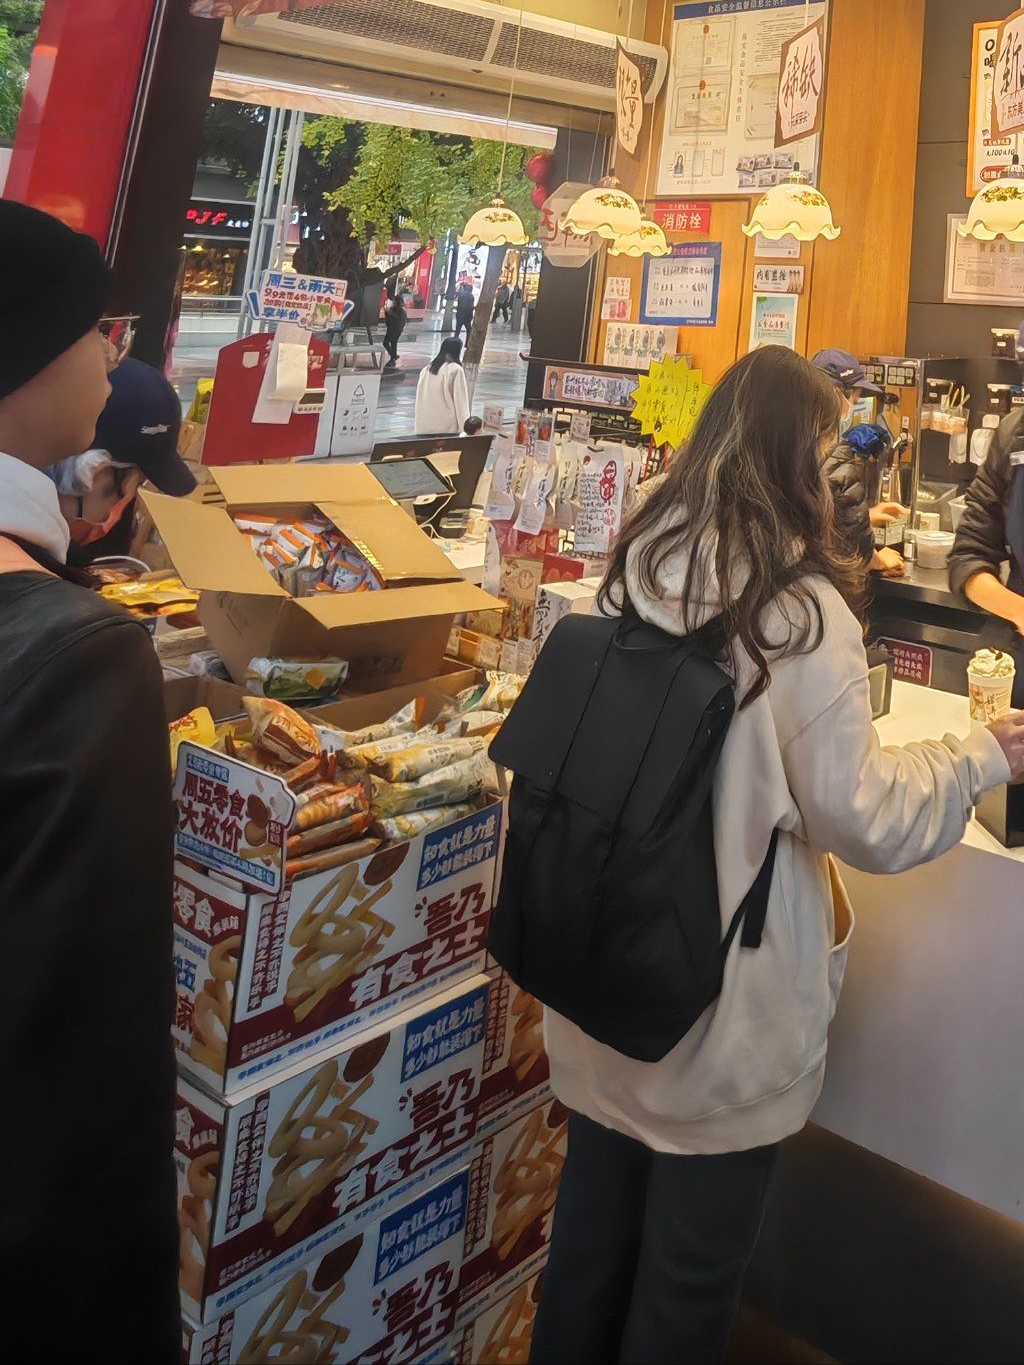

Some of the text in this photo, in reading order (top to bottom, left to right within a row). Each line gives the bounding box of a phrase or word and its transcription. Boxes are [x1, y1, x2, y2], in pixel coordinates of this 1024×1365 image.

[662, 212, 702, 230] 消防栓
[266, 274, 336, 295] 周三&雨天
[181, 770, 246, 822] 周五零食
[178, 799, 244, 854] 大放价
[424, 882, 488, 935] 吾乃
[349, 919, 486, 1011] 有食之士
[409, 1067, 476, 1128] 吾乃
[331, 1106, 474, 1216] 有食之士
[382, 1260, 455, 1335] 吾乃
[357, 1301, 451, 1365] 之士
